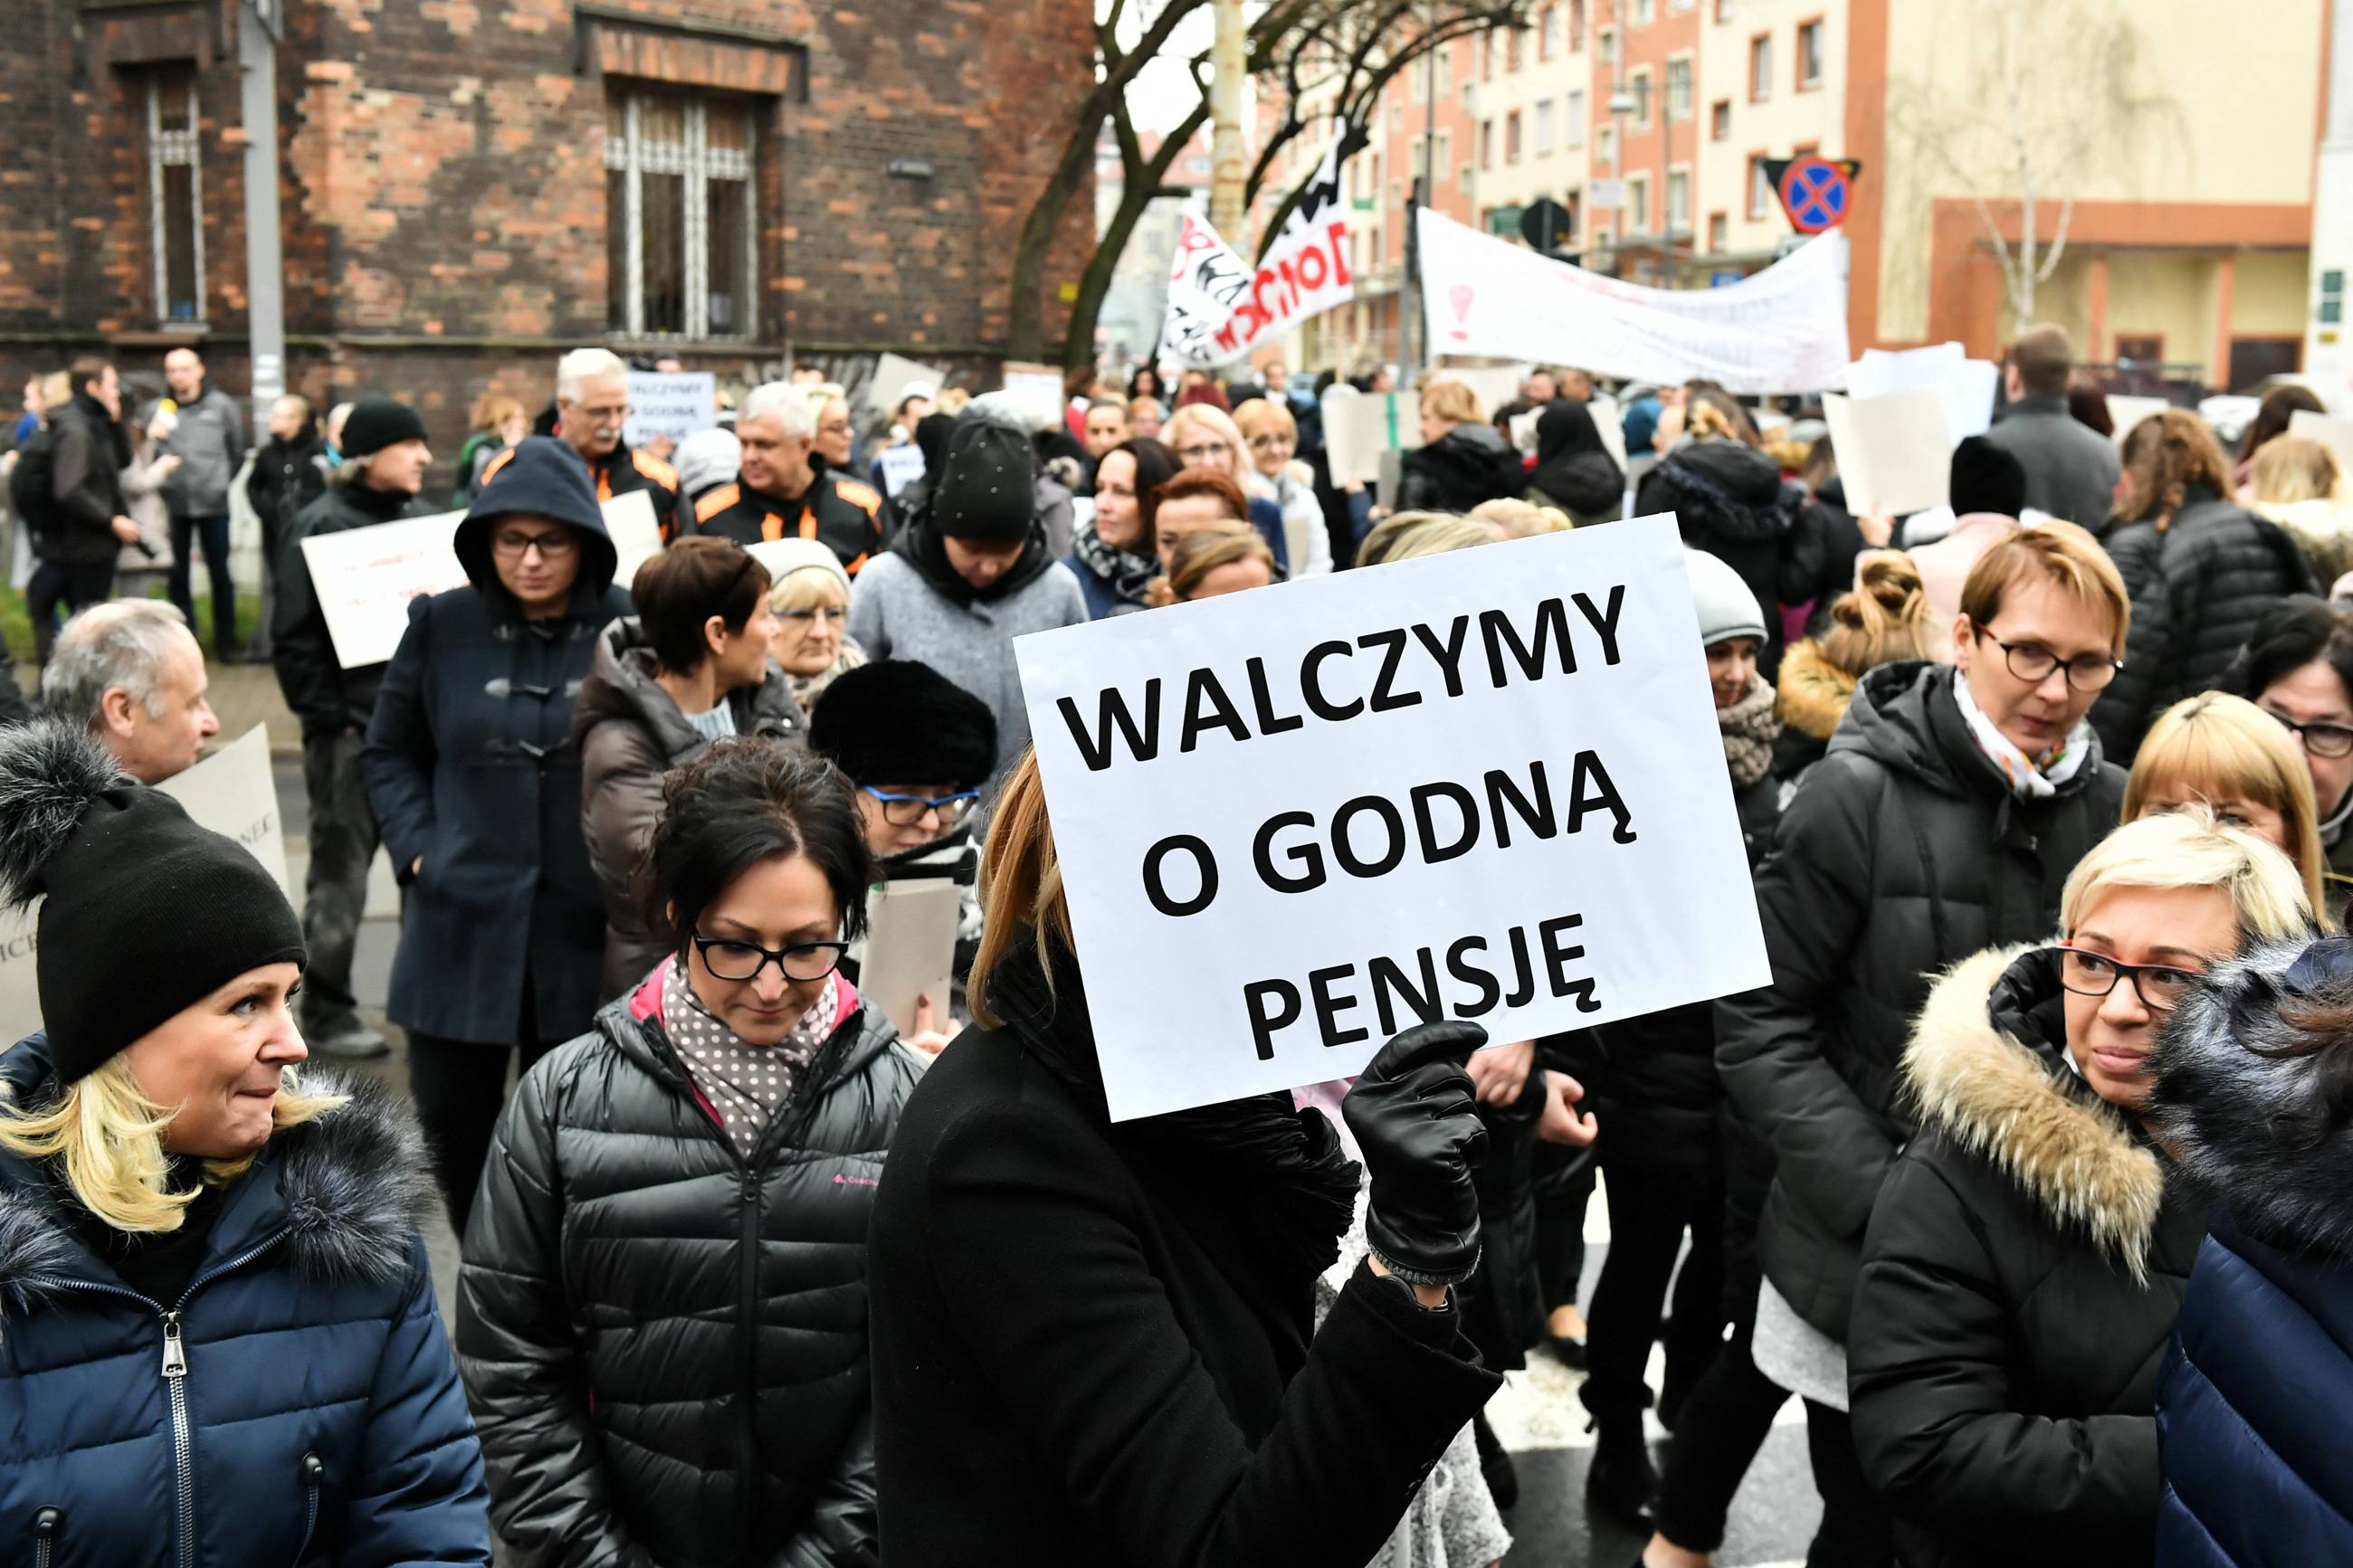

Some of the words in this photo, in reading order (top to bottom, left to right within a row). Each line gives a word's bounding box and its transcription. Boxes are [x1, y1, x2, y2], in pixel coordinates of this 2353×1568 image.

[1056, 584, 1624, 771] WALCZYMY
[1143, 834, 1218, 917] O
[1253, 749, 1636, 893] GODNĄ
[1244, 914, 1601, 1060] PENSJĘ
